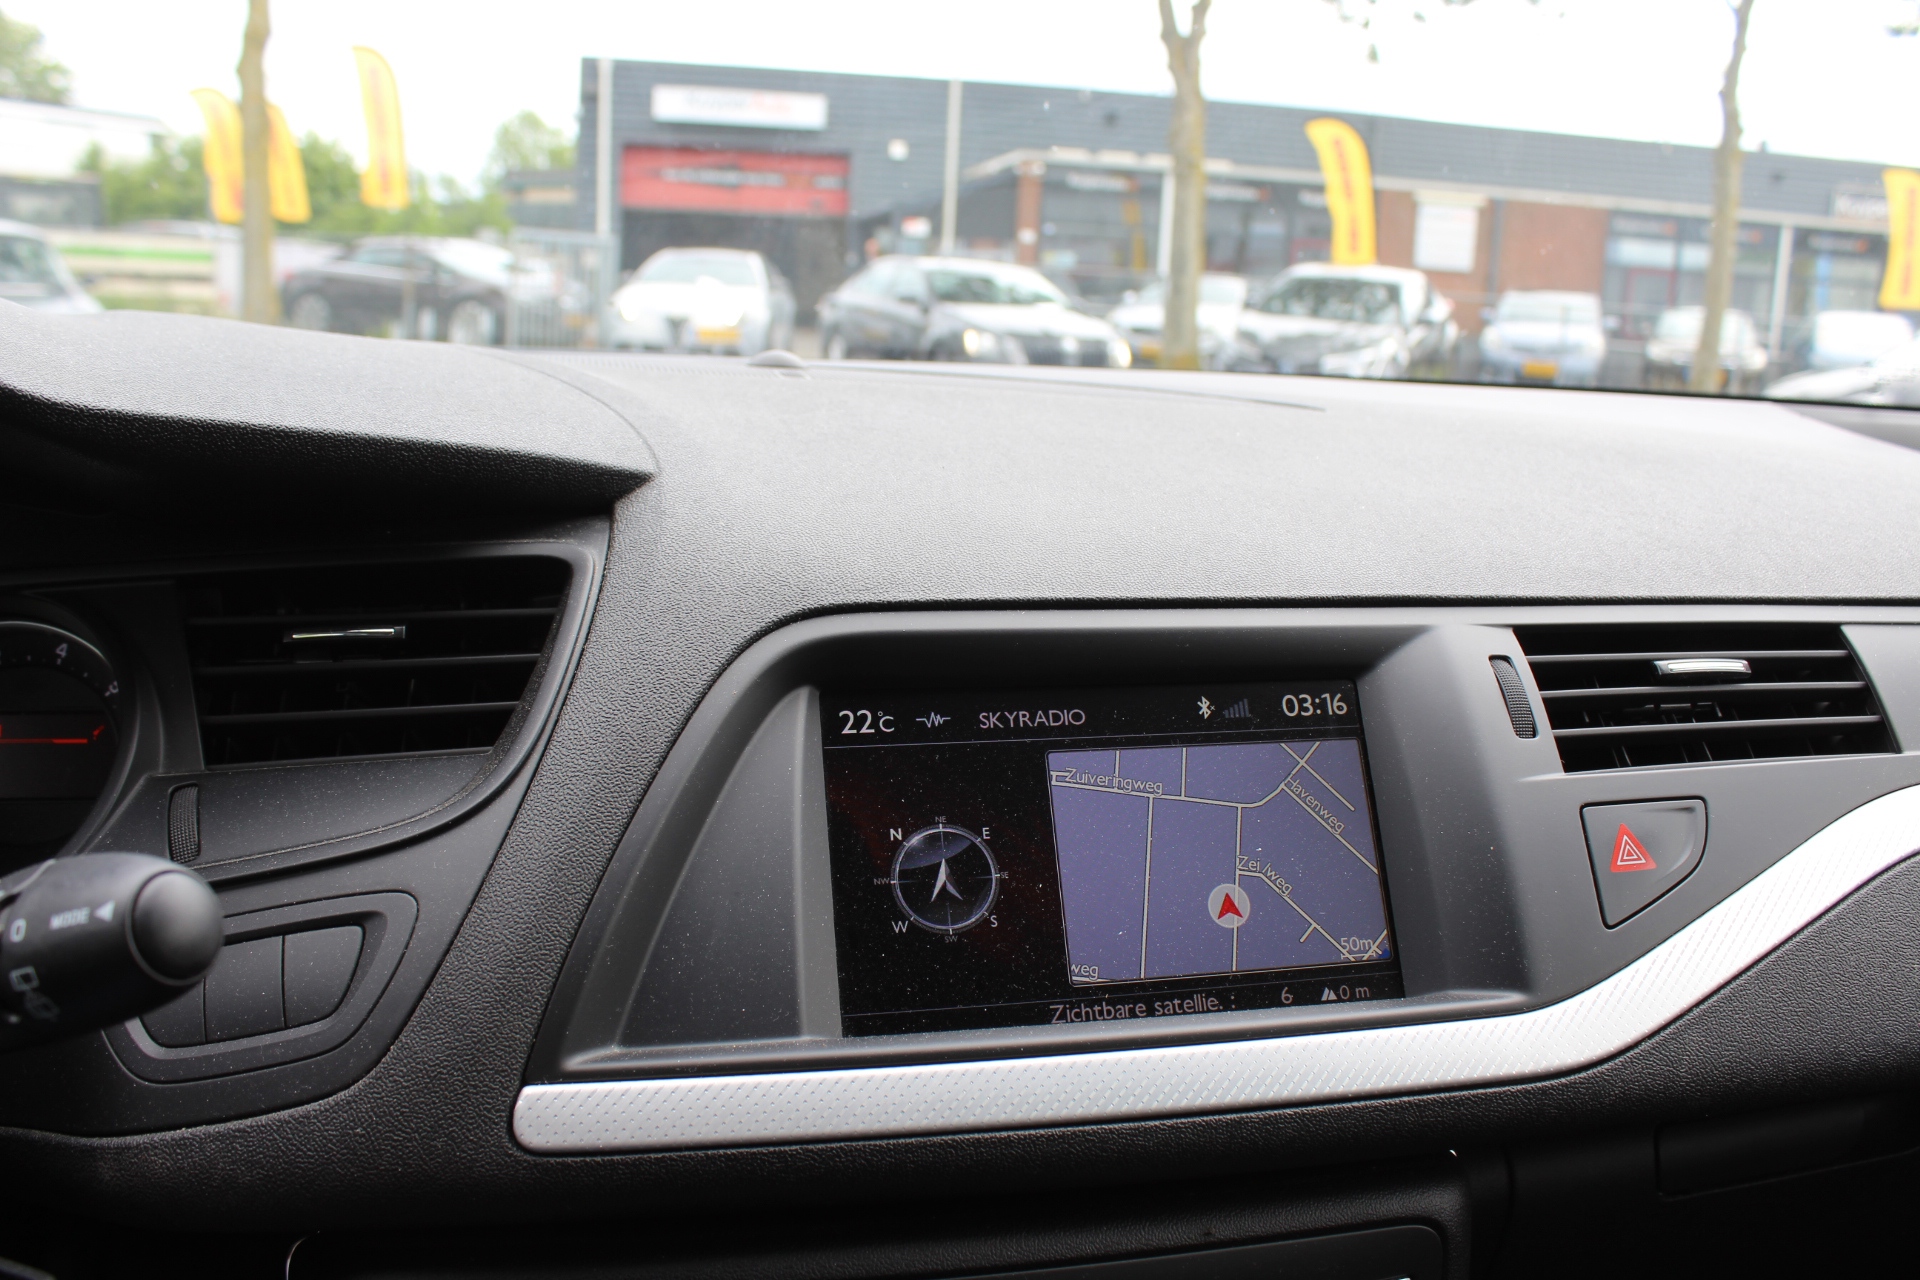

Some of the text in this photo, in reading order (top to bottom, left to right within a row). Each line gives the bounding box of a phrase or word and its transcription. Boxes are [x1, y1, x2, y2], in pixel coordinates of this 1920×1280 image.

[55, 643, 68, 658] 4
[1282, 693, 1348, 717] 03:16
[979, 709, 1086, 729] SKYRADIO
[1065, 767, 1163, 796] Zuiveringweg
[1285, 774, 1345, 834] Havenweg
[935, 816, 946, 824] NE
[889, 828, 903, 841] N
[982, 827, 991, 840] E
[874, 878, 890, 886] NW
[892, 921, 908, 934] W
[990, 916, 998, 927] S
[1340, 936, 1374, 952] 50m
[1340, 985, 1370, 999] 0 m
[1050, 1001, 1147, 1024] Zichtbare
[1281, 987, 1294, 1004] 6
